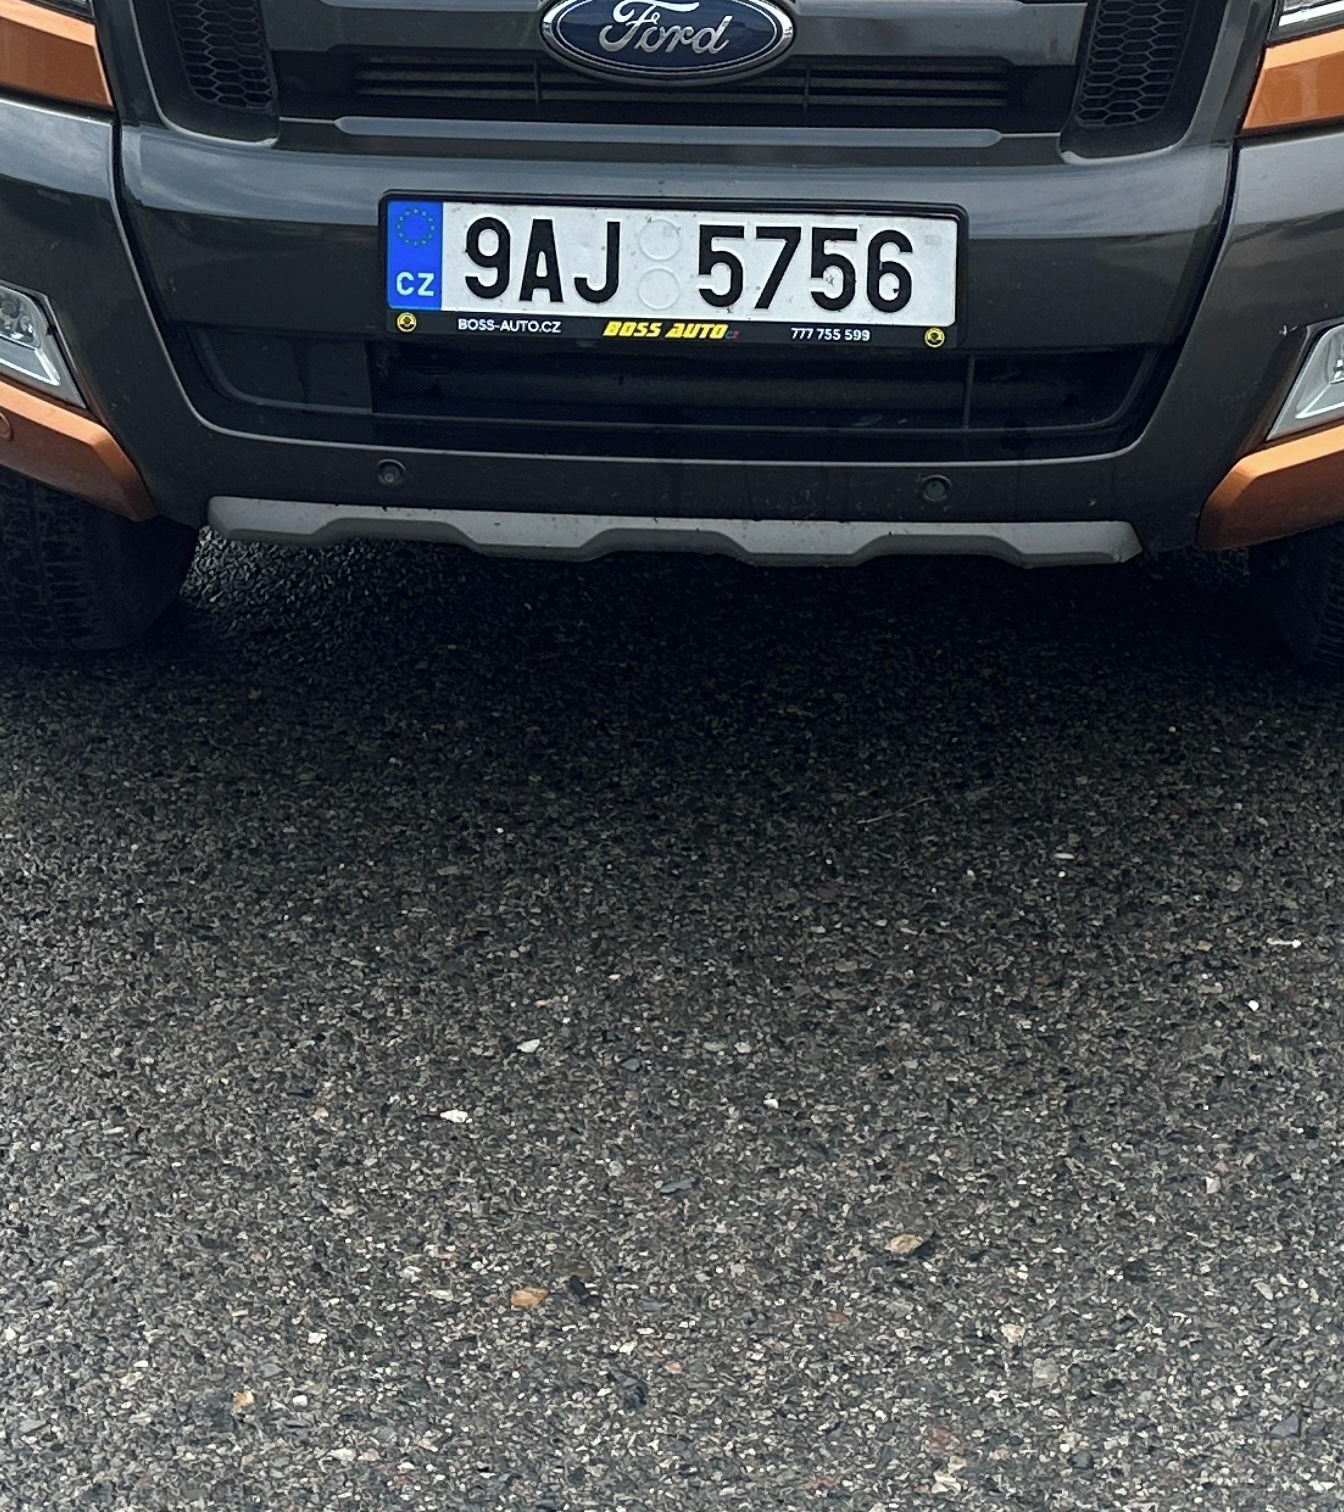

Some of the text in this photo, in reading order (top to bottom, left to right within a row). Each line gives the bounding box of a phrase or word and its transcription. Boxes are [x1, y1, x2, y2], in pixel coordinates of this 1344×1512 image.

[464, 217, 914, 313] 9AJ 5756
[396, 272, 435, 297] CZ
[458, 318, 562, 334] BOSS-AUTO.CZ
[602, 321, 662, 337] BOSS
[664, 322, 729, 339] AUTO
[790, 327, 871, 341] 777 755 599
